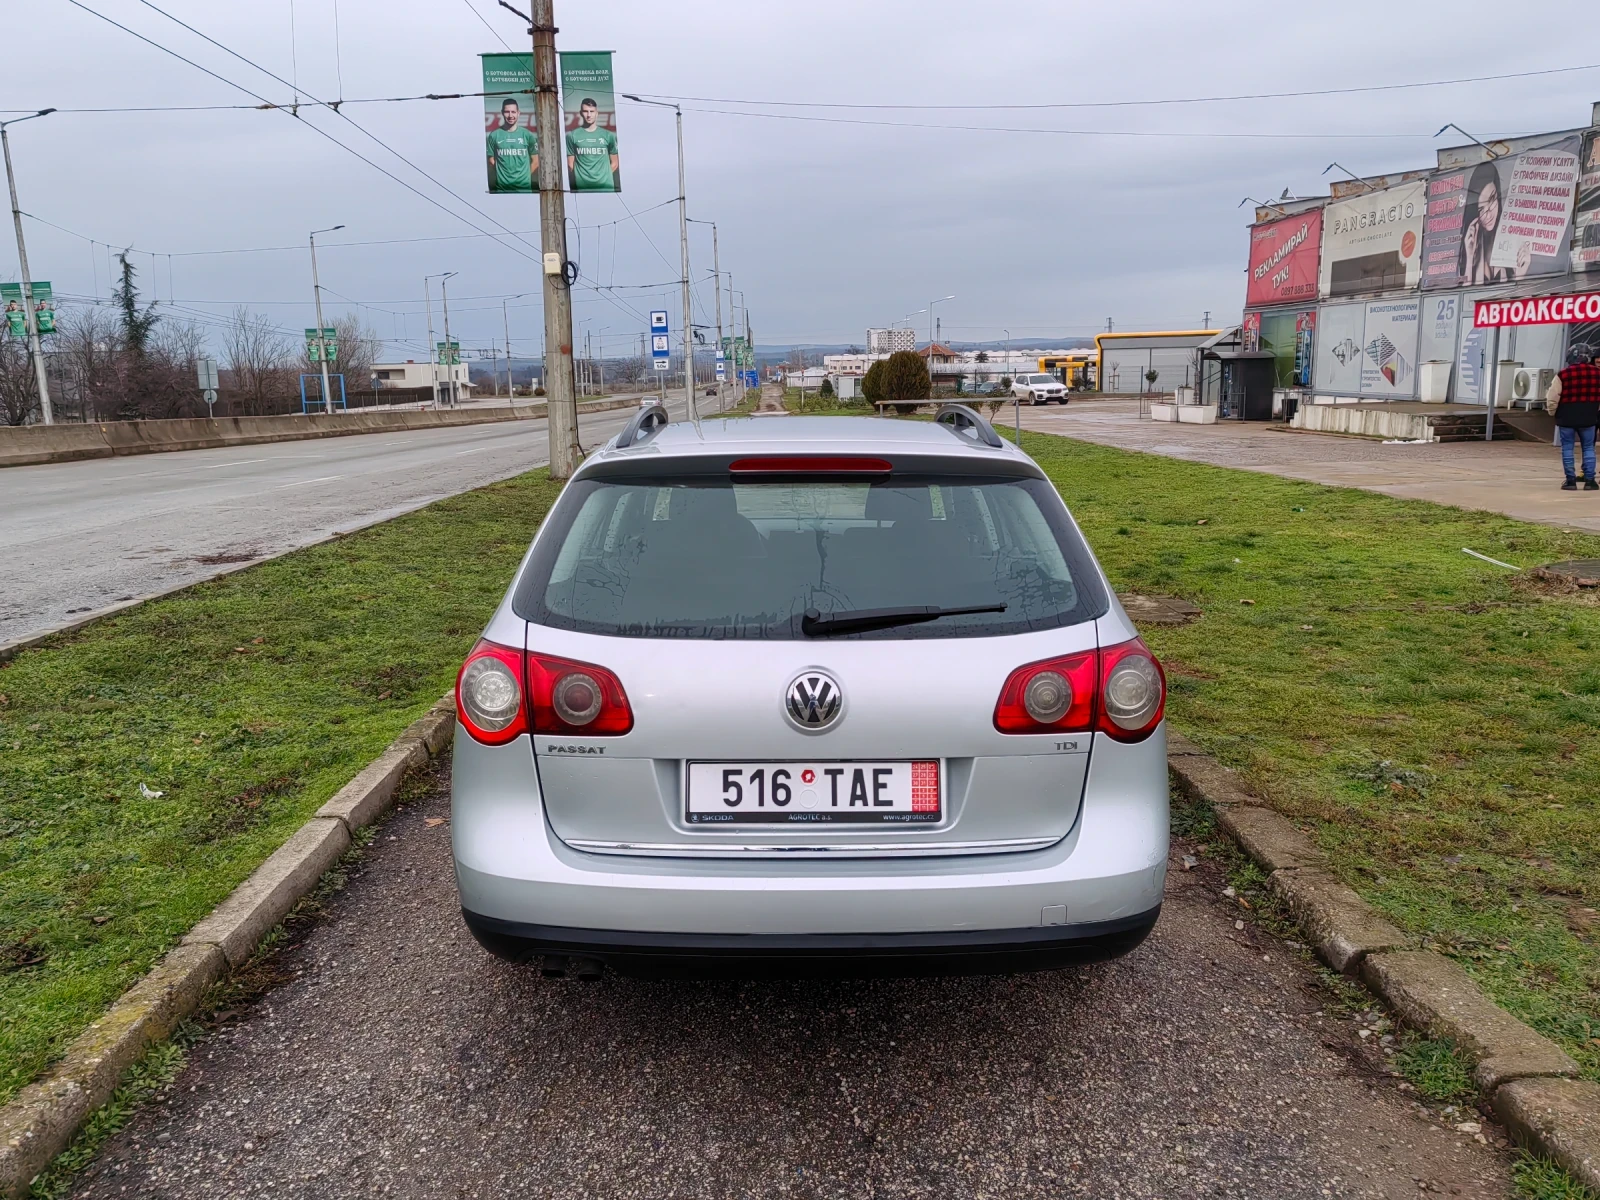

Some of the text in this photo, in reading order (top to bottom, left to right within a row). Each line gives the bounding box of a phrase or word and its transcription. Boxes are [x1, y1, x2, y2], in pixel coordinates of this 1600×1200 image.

[496, 148, 527, 156] WINBET
[576, 147, 607, 155] WINBET
[1553, 157, 1575, 167] УСЛУГИ
[1520, 170, 1574, 183] ГРАФИЧЕН ДИЗАЙН
[1518, 185, 1570, 197] ПЕЧАТНА РЕКЛАМА
[1539, 201, 1565, 212] РЕКЛАМА
[1334, 202, 1415, 235] PANCRACIO
[1508, 212, 1565, 227] РЕКЛАМНИ СУВЕНИРИ
[1367, 231, 1393, 241] CHOCOLATE
[1508, 225, 1558, 240] ФИРМЕНИ ПЕЧАТИ
[1254, 222, 1309, 282] РЕКЛАМИРАЙ
[1532, 242, 1556, 254] ТЕНИСКИ
[1272, 265, 1289, 289] ТУК!
[1281, 283, 1315, 296] 0897 888 333
[1436, 299, 1455, 320] 25
[1476, 295, 1600, 325] АВТОАКСЕСО
[1392, 314, 1418, 322] МАТЕРИАЛИ
[548, 744, 607, 754] PASSAT
[1054, 741, 1078, 750] TDI
[722, 768, 893, 807] 516 TAE
